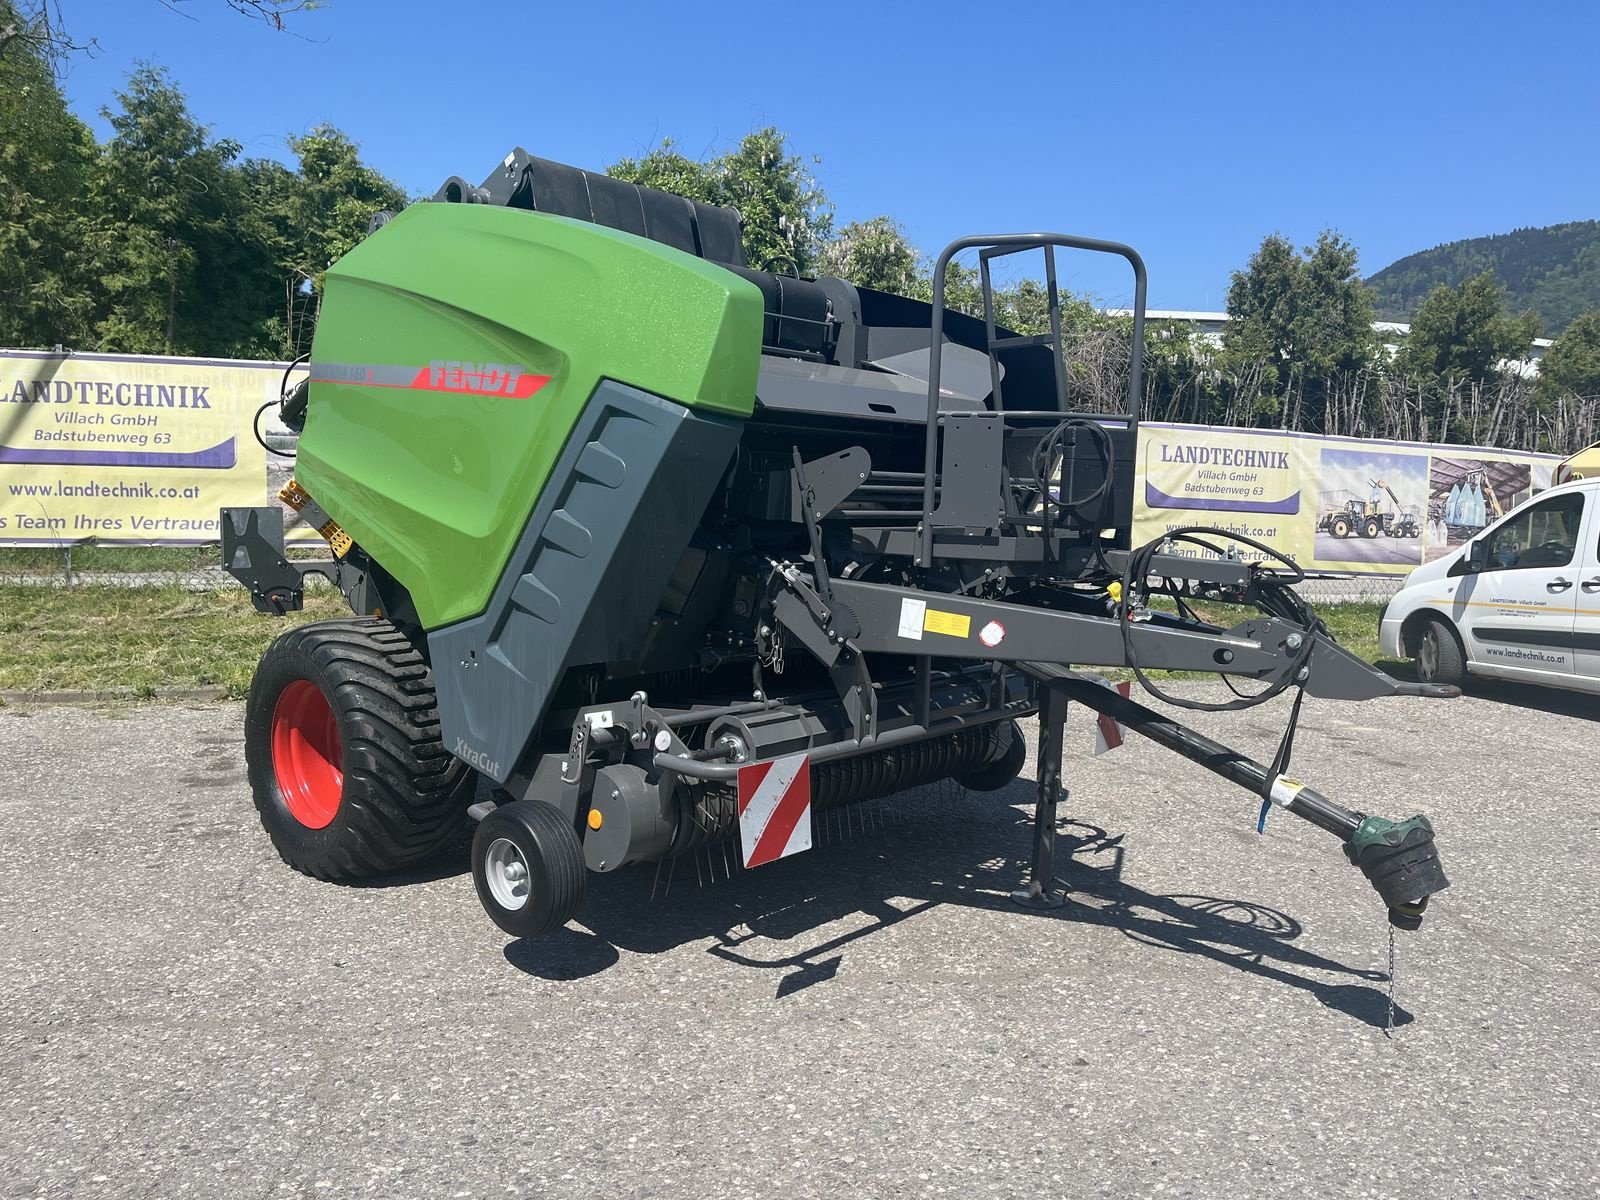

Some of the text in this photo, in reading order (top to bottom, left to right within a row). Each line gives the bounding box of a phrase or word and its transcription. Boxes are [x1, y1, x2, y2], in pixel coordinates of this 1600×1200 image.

[429, 359, 527, 394] FENDT
[54, 411, 158, 427] Villach GmbH
[34, 429, 172, 447] Badstubenweg 63
[1161, 444, 1289, 470] LANDTECHNIK
[1198, 470, 1258, 482] Villach GmbH
[9, 480, 200, 499] www.landtechnik.co.at
[1184, 482, 1264, 498] Badstubenweg 63
[15, 514, 66, 530] Team
[74, 514, 123, 530] Ihres
[1485, 647, 1565, 664] www.landtechnik.co.at
[454, 736, 500, 778] XtraCut
